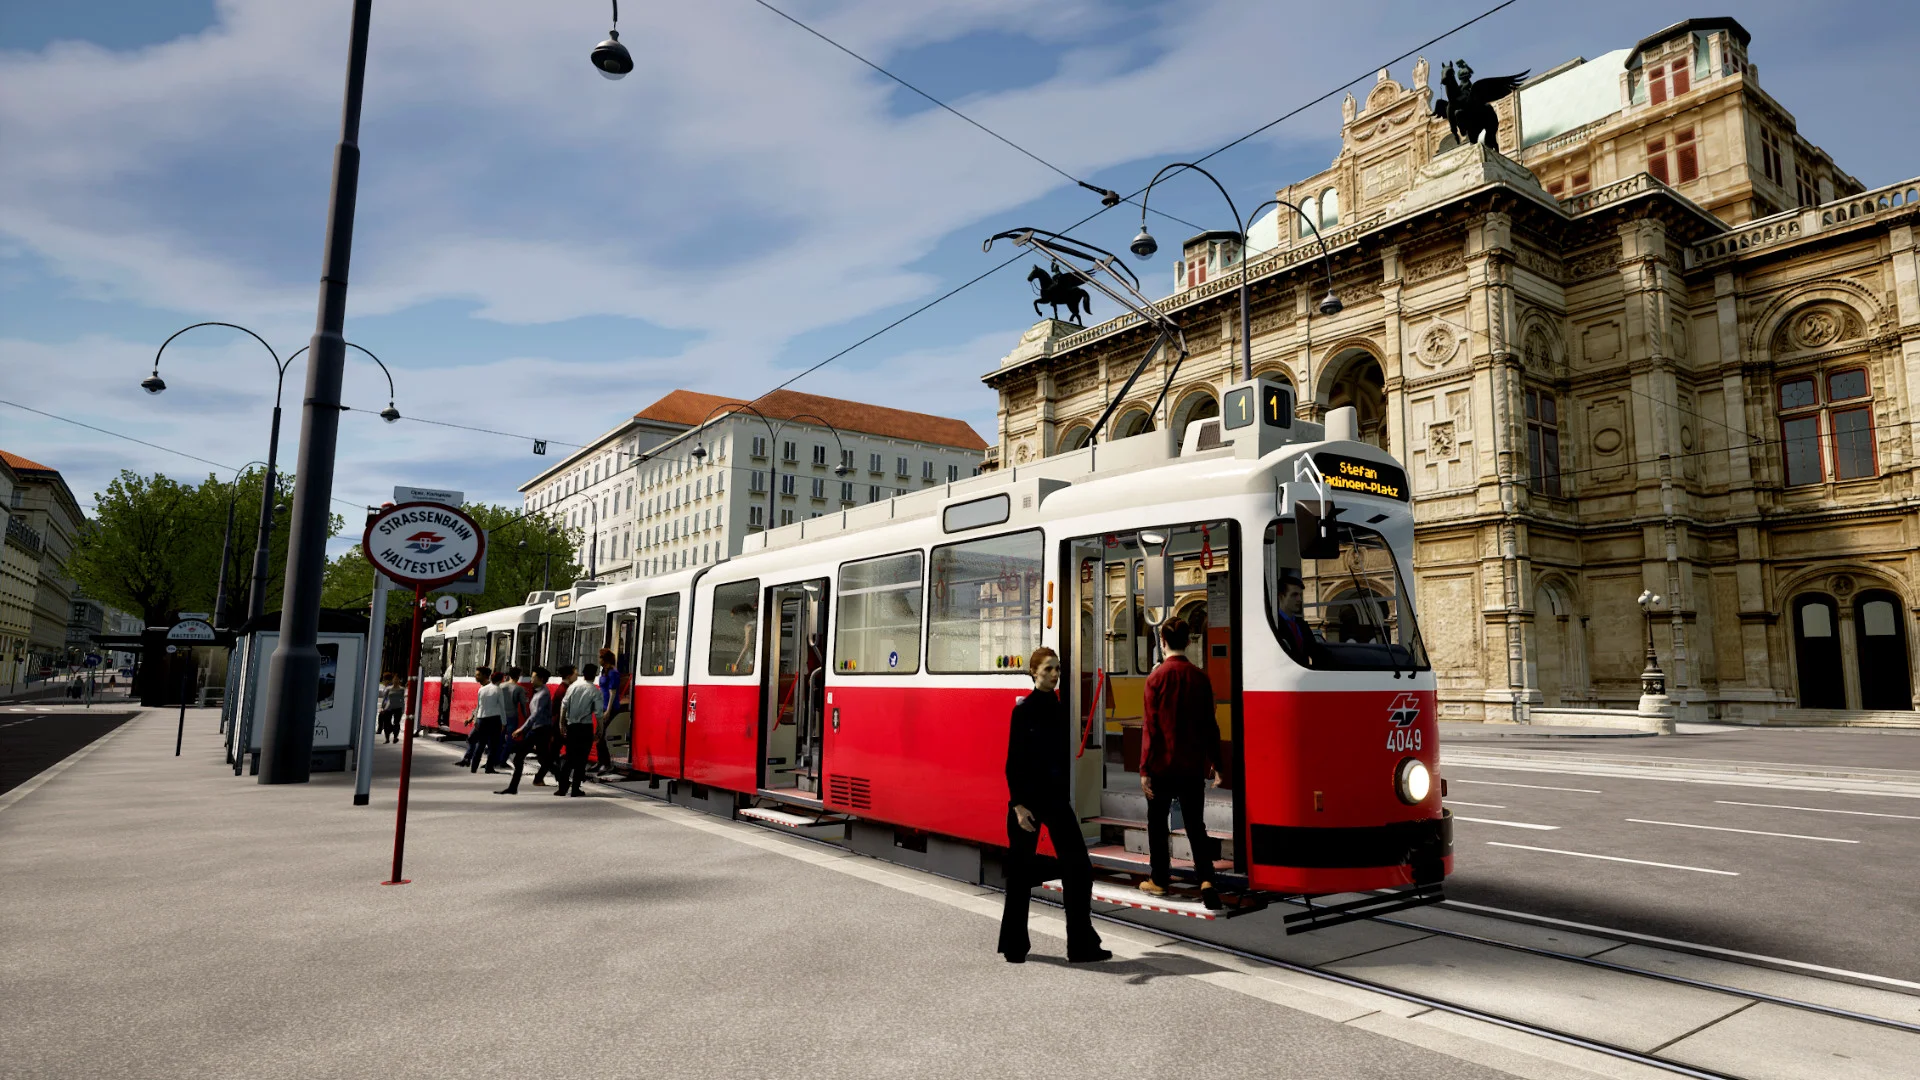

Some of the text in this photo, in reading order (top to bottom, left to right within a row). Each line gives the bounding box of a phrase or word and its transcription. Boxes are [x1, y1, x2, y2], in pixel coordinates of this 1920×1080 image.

[1238, 395, 1246, 421] 1
[1269, 394, 1278, 421] 1
[1339, 461, 1378, 479] Stefan
[379, 511, 472, 541] STRASSENBAHN
[380, 552, 466, 574] HALTESTELLE
[443, 599, 449, 610] 1
[1386, 728, 1422, 752] 4049
